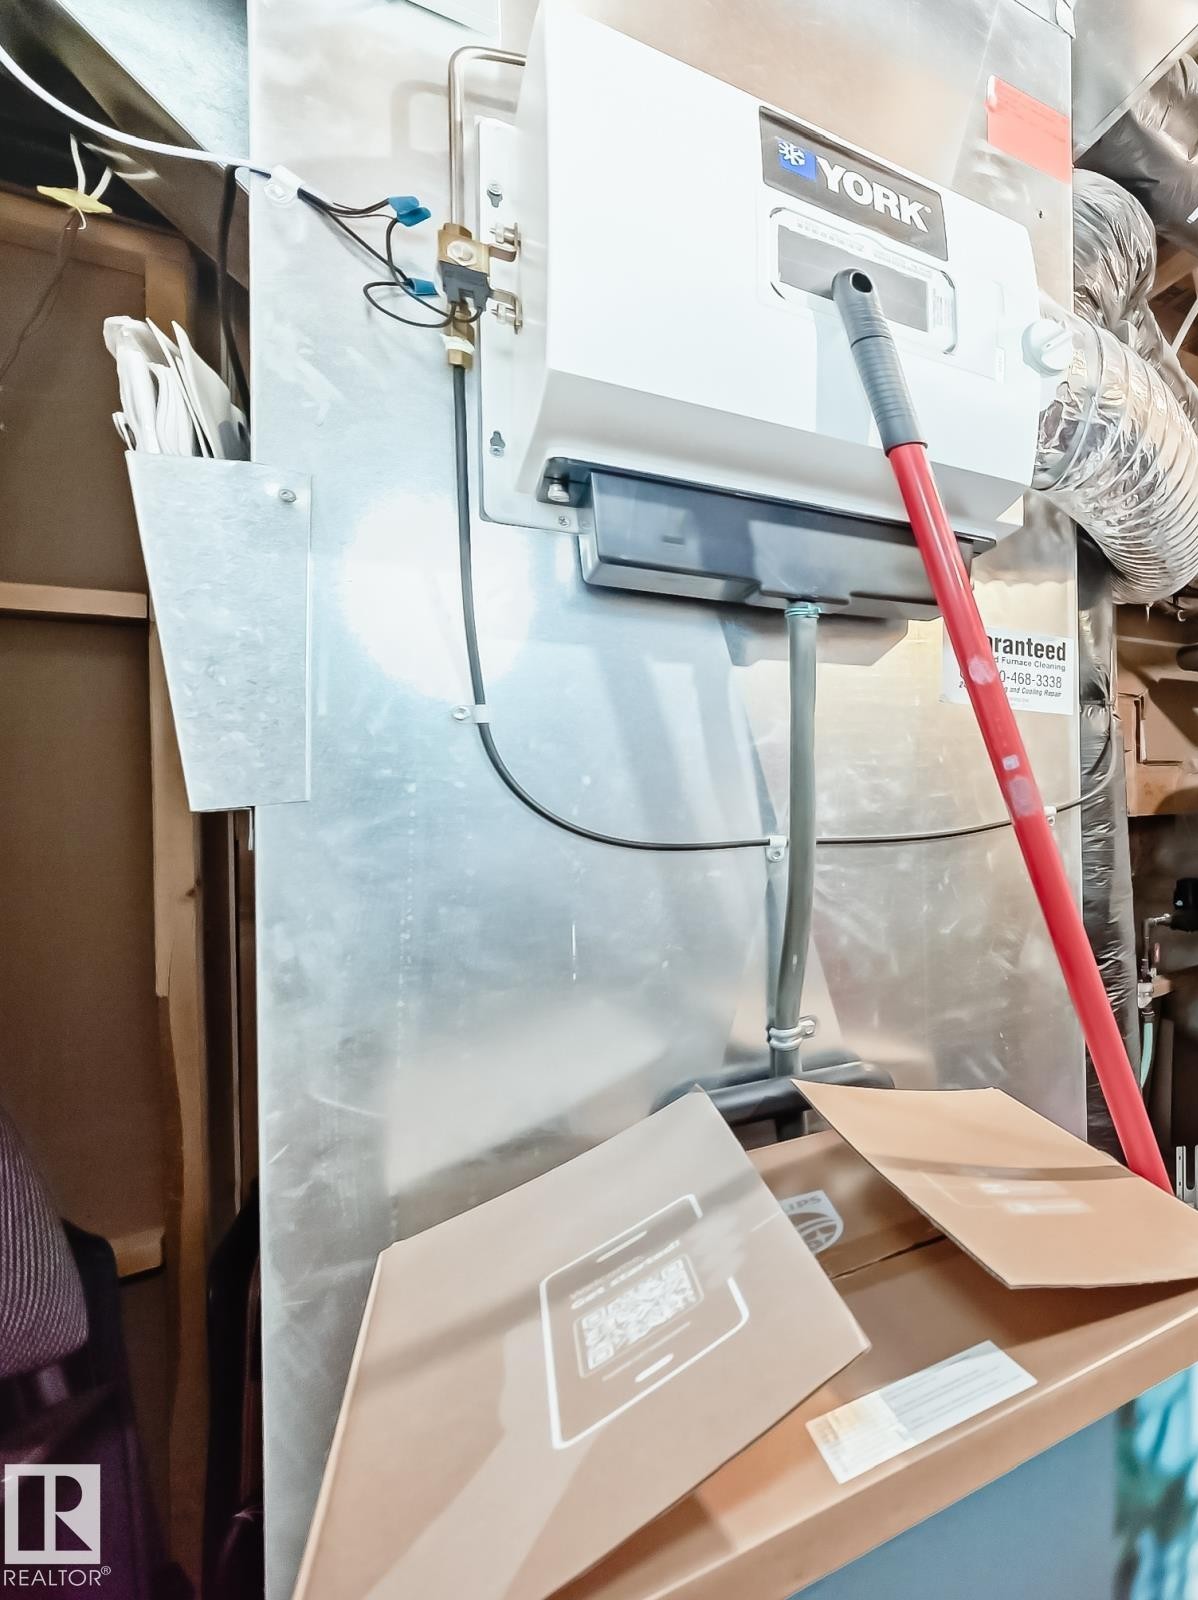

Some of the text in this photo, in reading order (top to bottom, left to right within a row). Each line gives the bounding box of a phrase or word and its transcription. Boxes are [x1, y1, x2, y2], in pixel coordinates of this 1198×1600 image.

[816, 155, 928, 233] YORK
[987, 635, 1066, 661] ranteed
[1001, 657, 1032, 667] Furnace
[1033, 660, 1066, 673] Cleaning
[1021, 687, 1043, 697] Cooling
[1044, 689, 1062, 698] Repair
